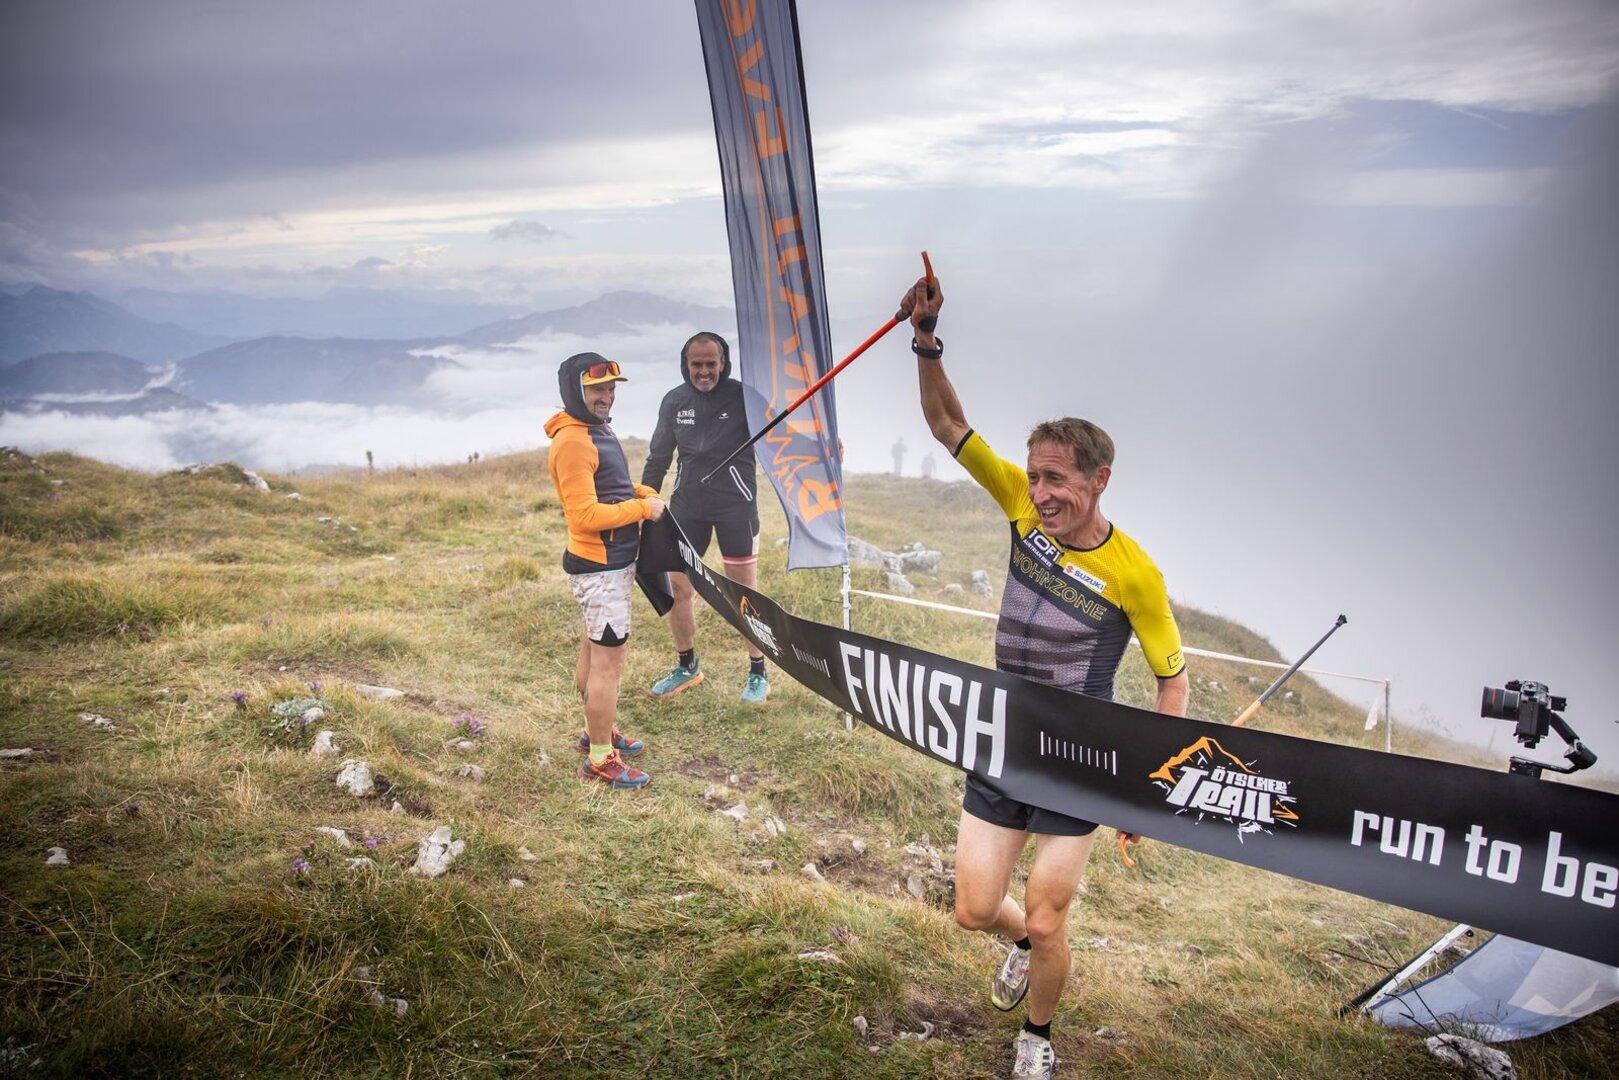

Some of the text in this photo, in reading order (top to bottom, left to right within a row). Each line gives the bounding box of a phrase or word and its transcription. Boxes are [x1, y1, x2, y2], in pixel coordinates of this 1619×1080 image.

[1074, 570, 1104, 590] SUZUKI
[839, 641, 1007, 779] FINISH
[1350, 809, 1619, 909] run to be
